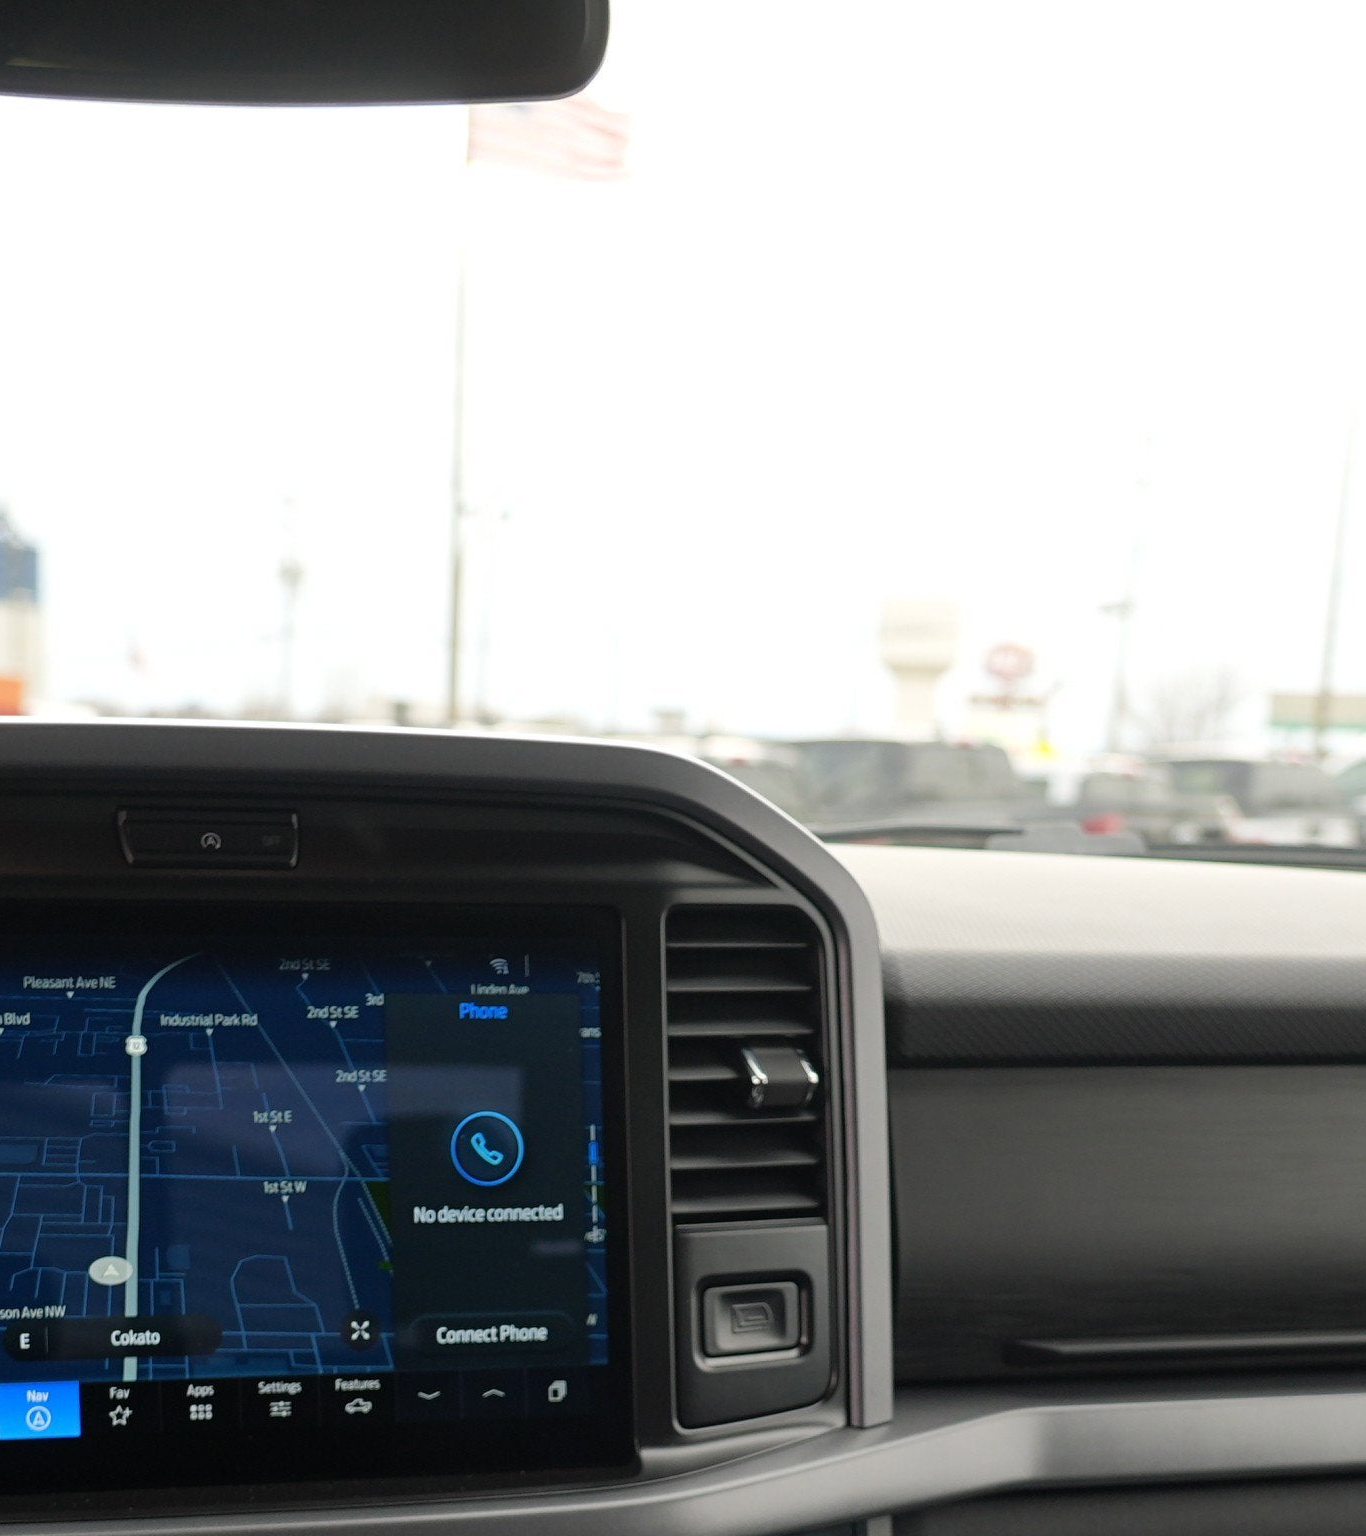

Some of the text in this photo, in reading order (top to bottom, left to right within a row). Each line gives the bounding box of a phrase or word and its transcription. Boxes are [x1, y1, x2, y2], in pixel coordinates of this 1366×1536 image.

[23, 976, 116, 989] Pleasant Ave NE
[307, 1006, 359, 1019] 2nd St SE
[459, 1002, 509, 1020] Phone
[4, 1012, 31, 1025] Blvd
[160, 1013, 258, 1027] Industrial Park Rd
[336, 1070, 387, 1083] 2nd St SE
[253, 1110, 293, 1124] 1st St E
[263, 1181, 308, 1194] 1st St W
[413, 1203, 564, 1224] No device connected
[21, 1306, 44, 1319] Ave
[44, 1305, 67, 1318] NW
[19, 1333, 31, 1349] E
[111, 1329, 161, 1347] Cokato
[436, 1324, 549, 1345] Connect Phone
[186, 1384, 215, 1397] Apps
[257, 1381, 302, 1395] Settings
[334, 1378, 381, 1391] Features
[26, 1390, 49, 1402] Nav
[109, 1387, 130, 1400] Fav
